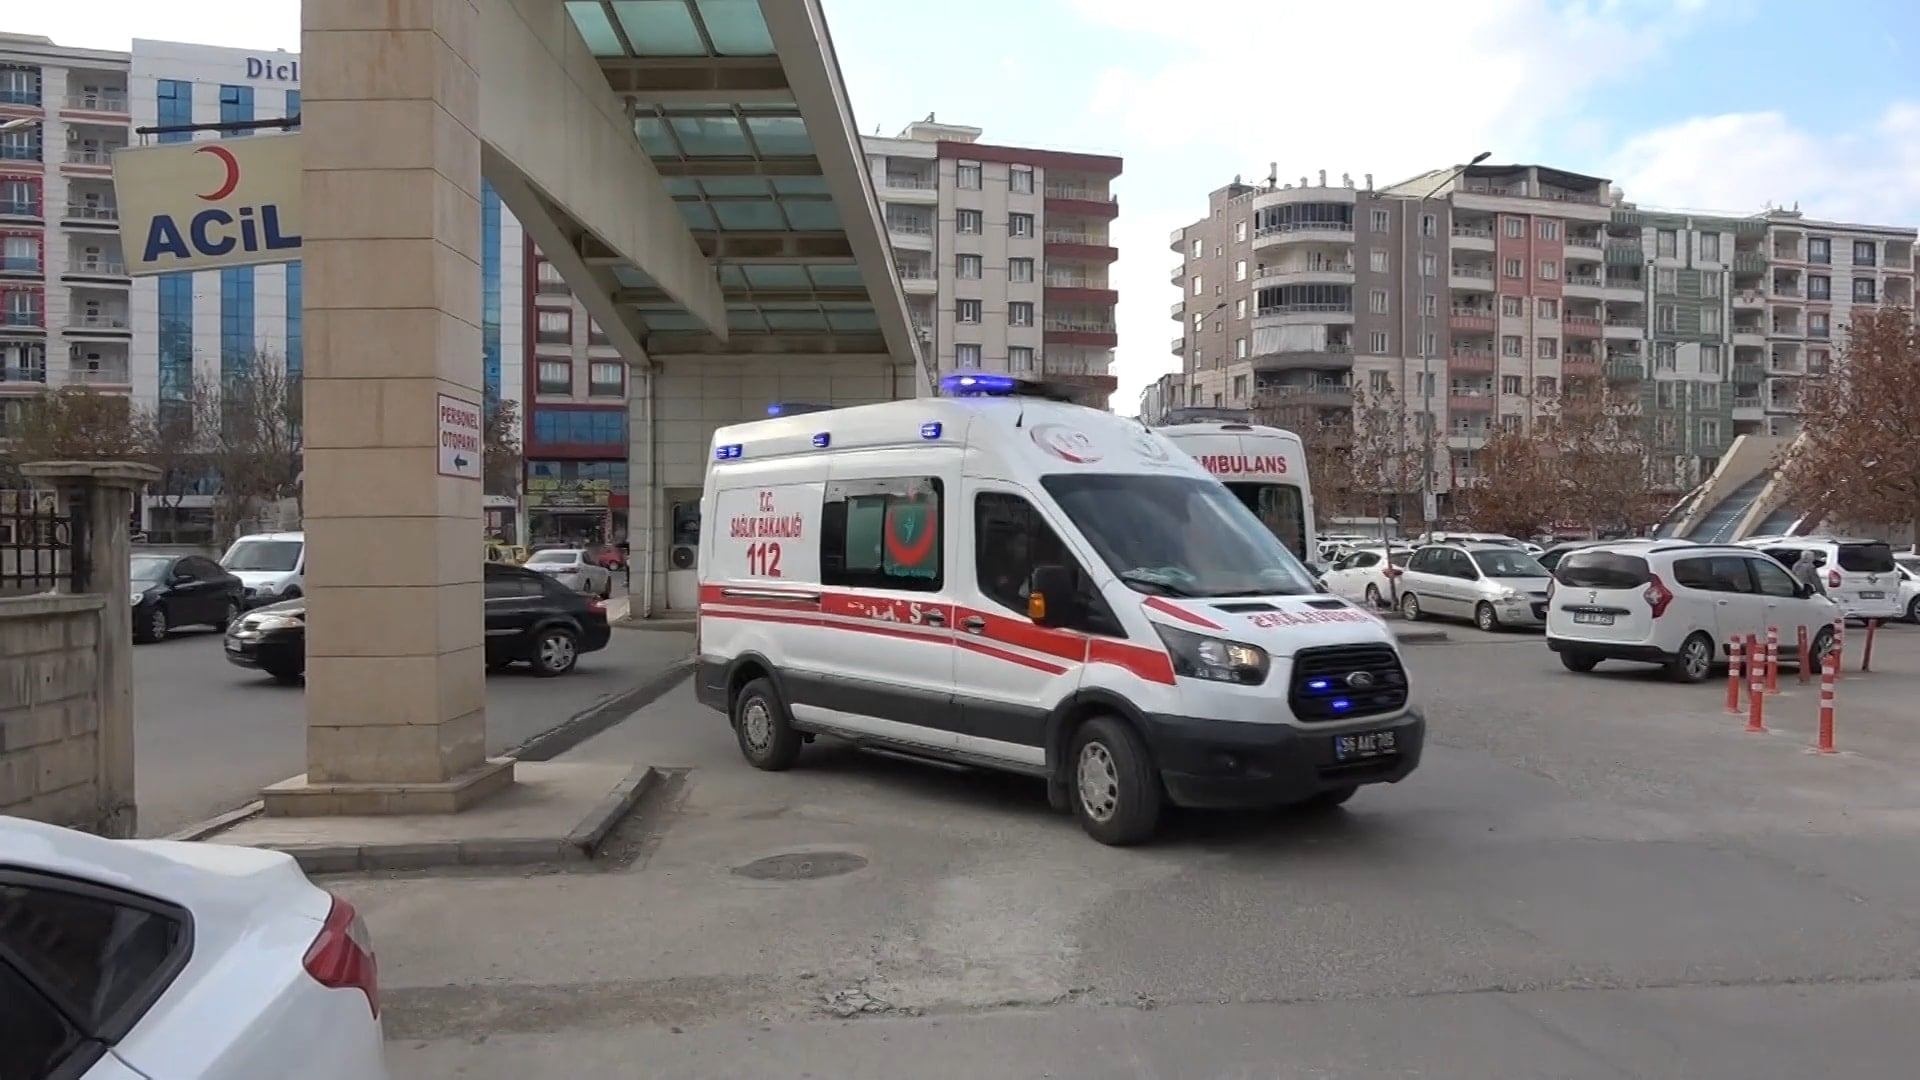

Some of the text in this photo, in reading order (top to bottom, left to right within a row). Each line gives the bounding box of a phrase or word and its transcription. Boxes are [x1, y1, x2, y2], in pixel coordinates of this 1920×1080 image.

[441, 406, 479, 431] PERSONEL
[442, 431, 478, 453] OTOPARKI
[747, 542, 782, 577] 112
